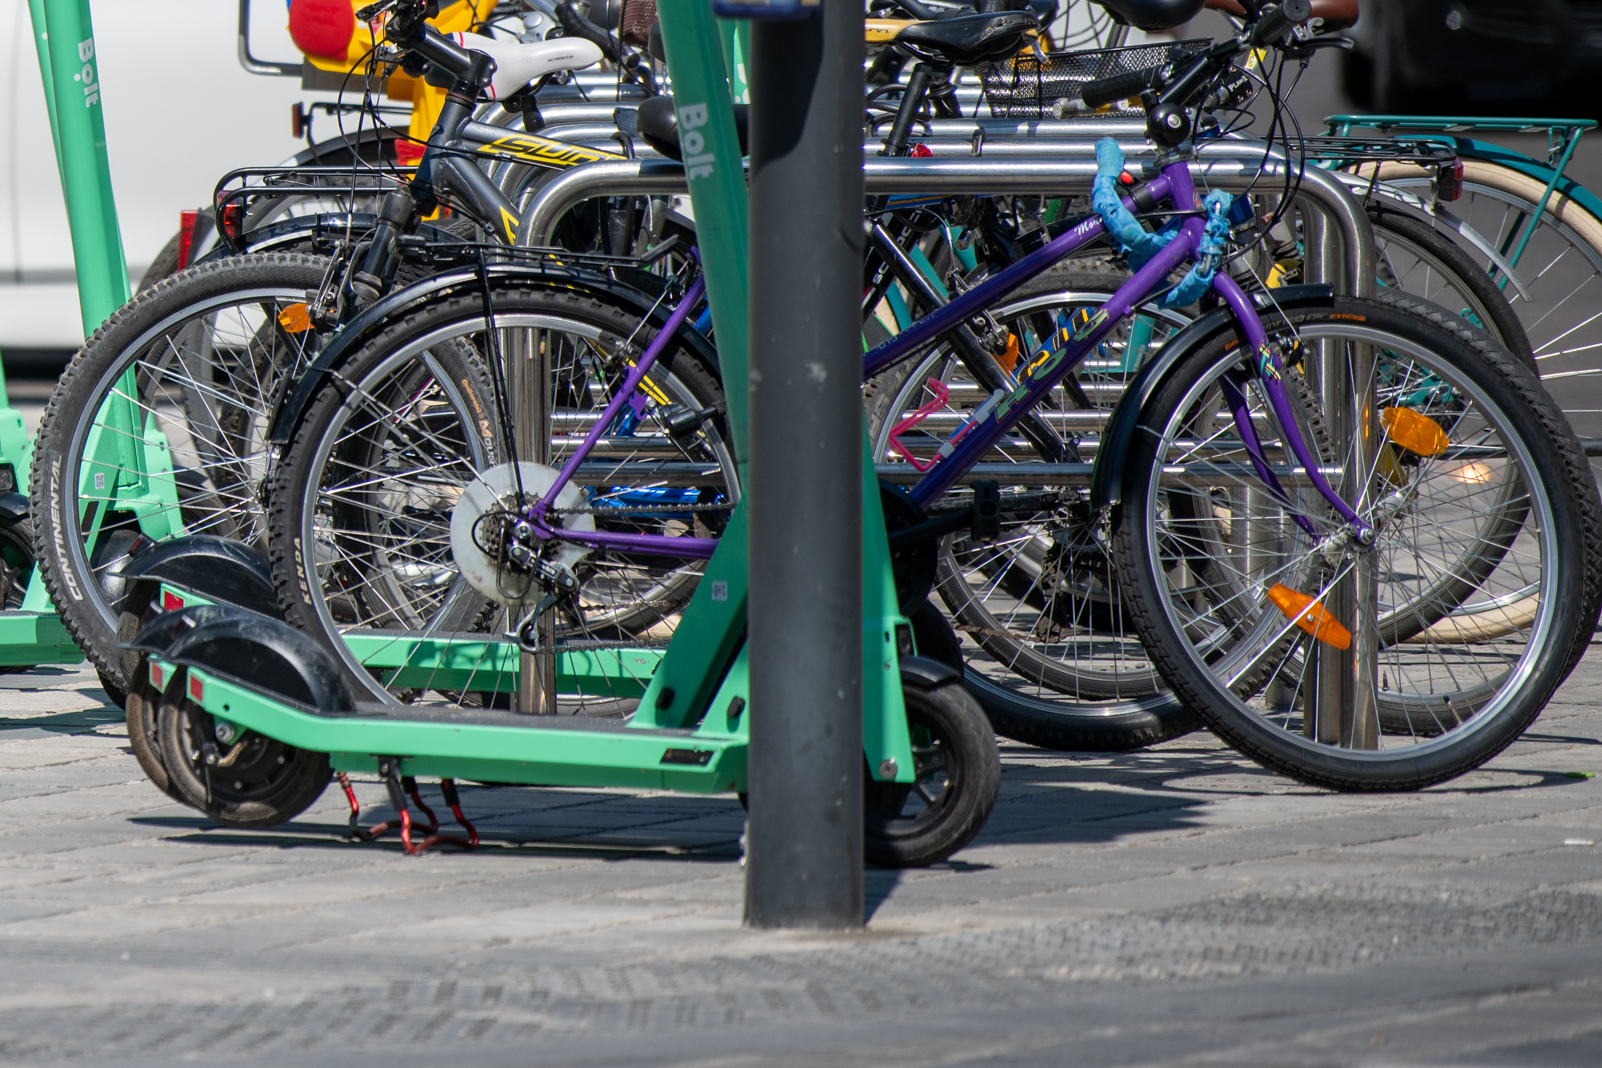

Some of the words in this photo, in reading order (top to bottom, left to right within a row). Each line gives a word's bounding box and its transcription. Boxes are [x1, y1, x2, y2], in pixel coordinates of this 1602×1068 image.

[74, 37, 99, 109] Bolt
[678, 102, 715, 181] Bolt
[461, 379, 482, 414] Continental
[478, 420, 496, 468] MOUN
[50, 454, 84, 601] CONTINENTAL
[294, 537, 312, 605] KENDA
